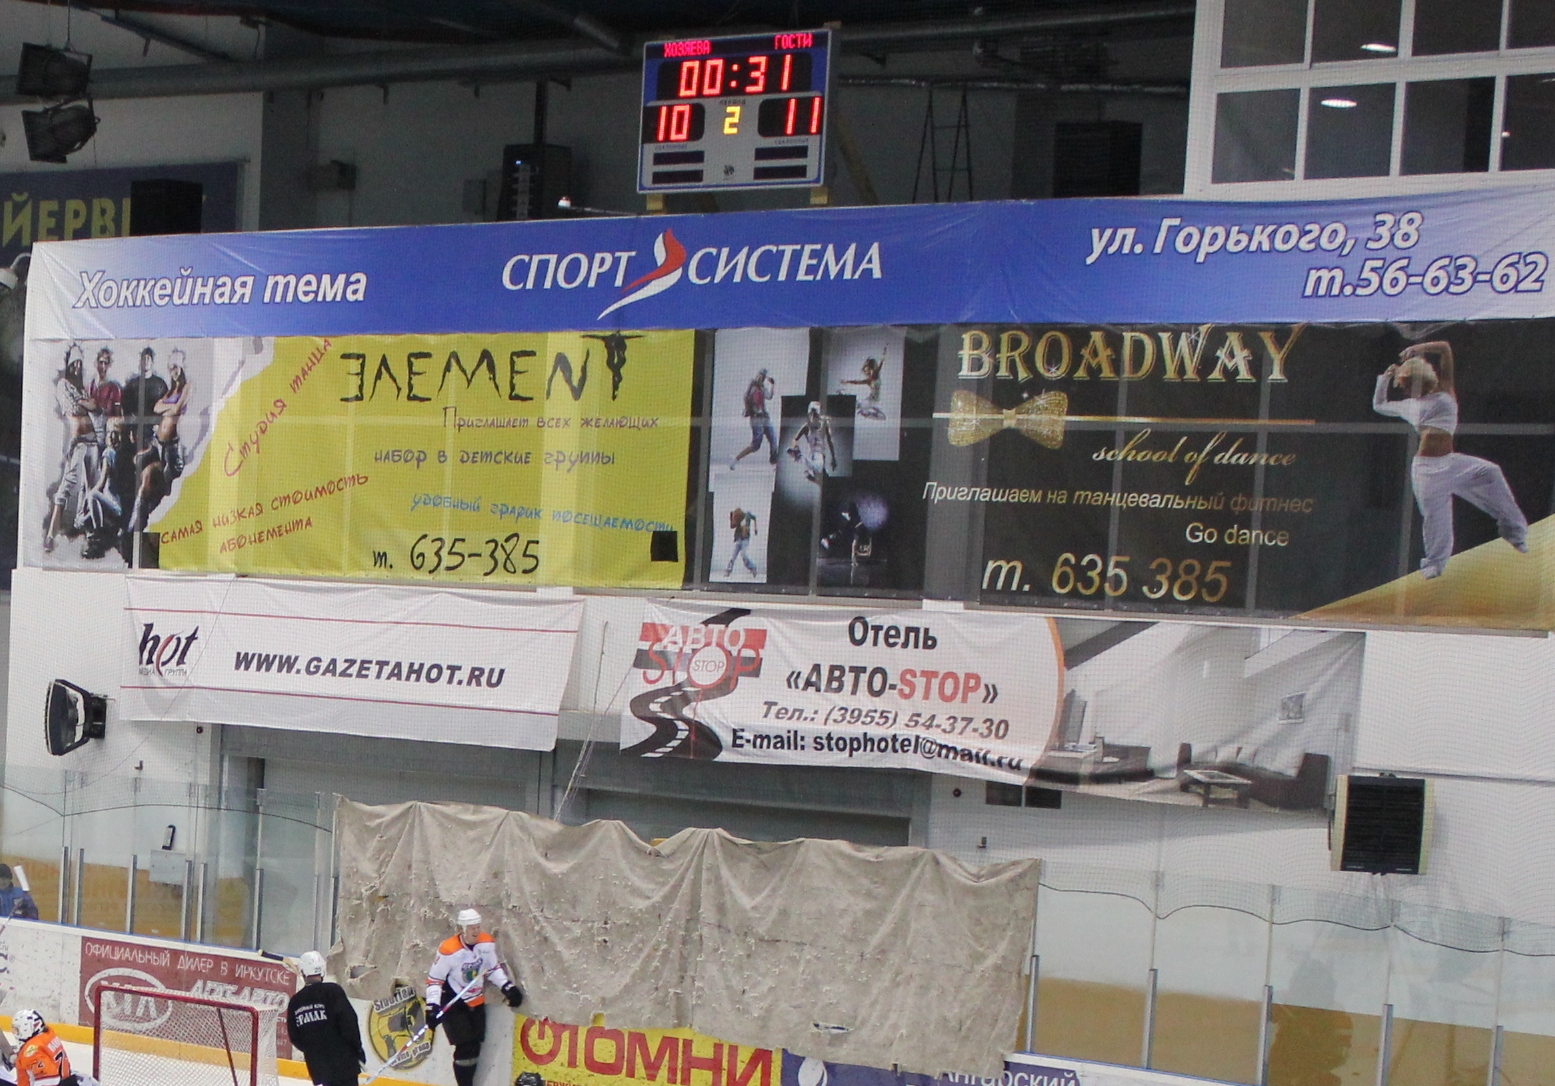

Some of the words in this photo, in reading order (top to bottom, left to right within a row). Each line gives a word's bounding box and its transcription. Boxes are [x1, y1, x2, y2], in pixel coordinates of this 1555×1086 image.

[664, 40, 712, 58] ХОЗЯЕВА
[774, 32, 813, 50] ГОСТИ
[678, 53, 793, 98] 00:31
[657, 103, 692, 142] 10
[722, 105, 741, 135] 2
[785, 96, 822, 136] 11
[1085, 223, 1144, 266] ул.
[1152, 217, 1356, 263] Горького,
[1365, 211, 1424, 251] 38
[501, 246, 637, 292] СПОРТ
[687, 240, 885, 288] СИСТЕМА
[72, 266, 255, 310] Хоккейная
[262, 270, 368, 304] тема
[957, 322, 1310, 384] BROADWAY
[1092, 430, 1178, 467] school
[1185, 431, 1228, 486] of
[1215, 430, 1296, 468] dance
[922, 481, 1042, 507] Приглашаем
[1046, 488, 1068, 504] на
[1073, 486, 1225, 511] танцевальный
[1230, 493, 1314, 515] фитнес
[409, 532, 540, 577] 635-385
[1185, 521, 1219, 546] Go
[1225, 523, 1290, 548] dance
[1051, 552, 1129, 597] 635
[1143, 558, 1232, 602] 385
[138, 622, 200, 677] hot
[847, 615, 939, 651] Отель
[233, 650, 507, 689] WWW.GAZETAHOT.RU
[692, 659, 726, 674] STOP
[762, 700, 818, 725] Тел.:
[823, 705, 899, 731] (3955)
[905, 711, 1010, 742] 54-37-30
[730, 729, 807, 753] E-mail:
[812, 731, 1025, 772] stophotel@mail.ru
[85, 941, 171, 967] ОФИЦИАЛЬНЫЙ
[177, 954, 214, 974] ДИЛЕР
[220, 962, 229, 976] В
[234, 963, 291, 986] ИРКУТСКЕ
